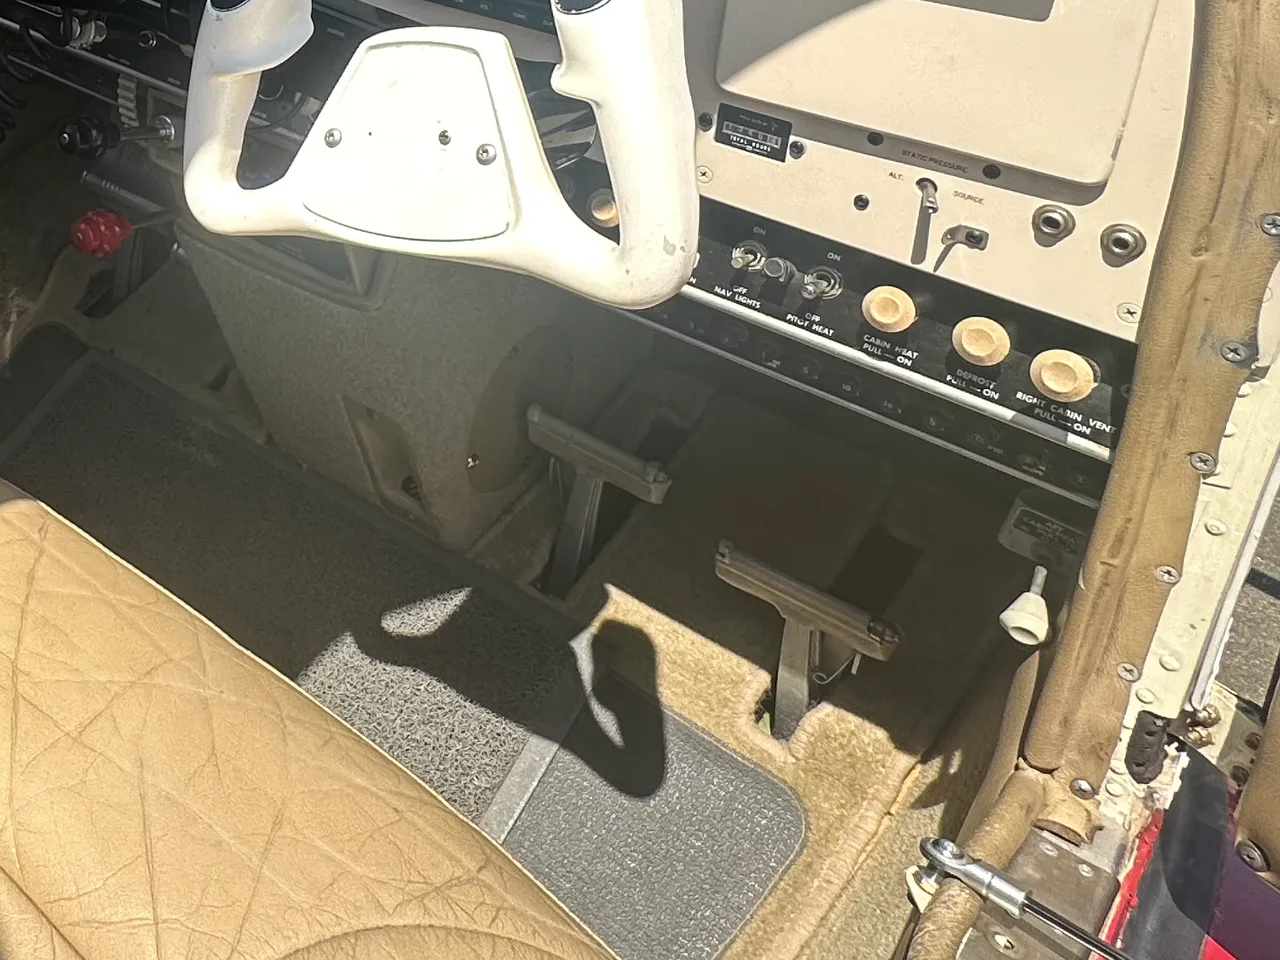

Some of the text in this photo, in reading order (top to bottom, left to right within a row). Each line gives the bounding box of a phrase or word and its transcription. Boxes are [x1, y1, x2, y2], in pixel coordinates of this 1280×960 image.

[901, 149, 968, 174] STATIC PRESSURE
[952, 190, 985, 206] SOURCE
[753, 226, 766, 236] ON
[826, 252, 841, 261] ON
[713, 285, 762, 310] NAV LIGHTS
[733, 284, 748, 295] OFF
[786, 313, 836, 338] PITOT HEAT
[805, 312, 822, 323] OFF
[862, 342, 913, 367] PULL ON
[863, 334, 919, 360] CABIN HEAT
[946, 374, 1000, 400] PULL ON
[956, 368, 997, 389] DEFROST
[1015, 391, 1118, 434] RIGHT CABIN VENT
[1033, 407, 1092, 435] PULL ON
